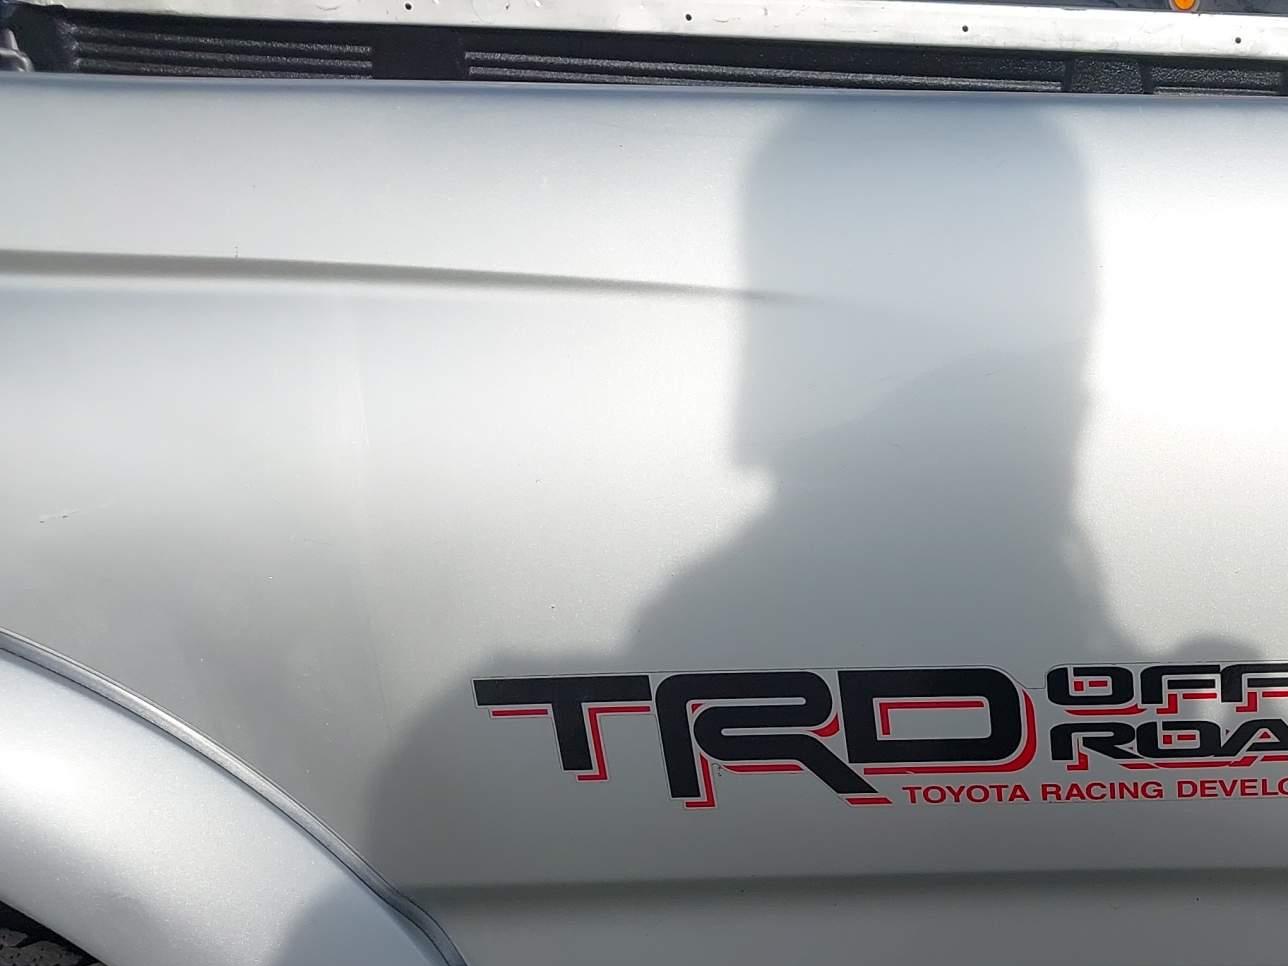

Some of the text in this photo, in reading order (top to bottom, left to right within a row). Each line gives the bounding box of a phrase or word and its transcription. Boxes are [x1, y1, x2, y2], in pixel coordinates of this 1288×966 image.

[472, 667, 1036, 807] TRD
[902, 784, 1028, 803] TOYOTA
[1041, 780, 1164, 801] RACING
